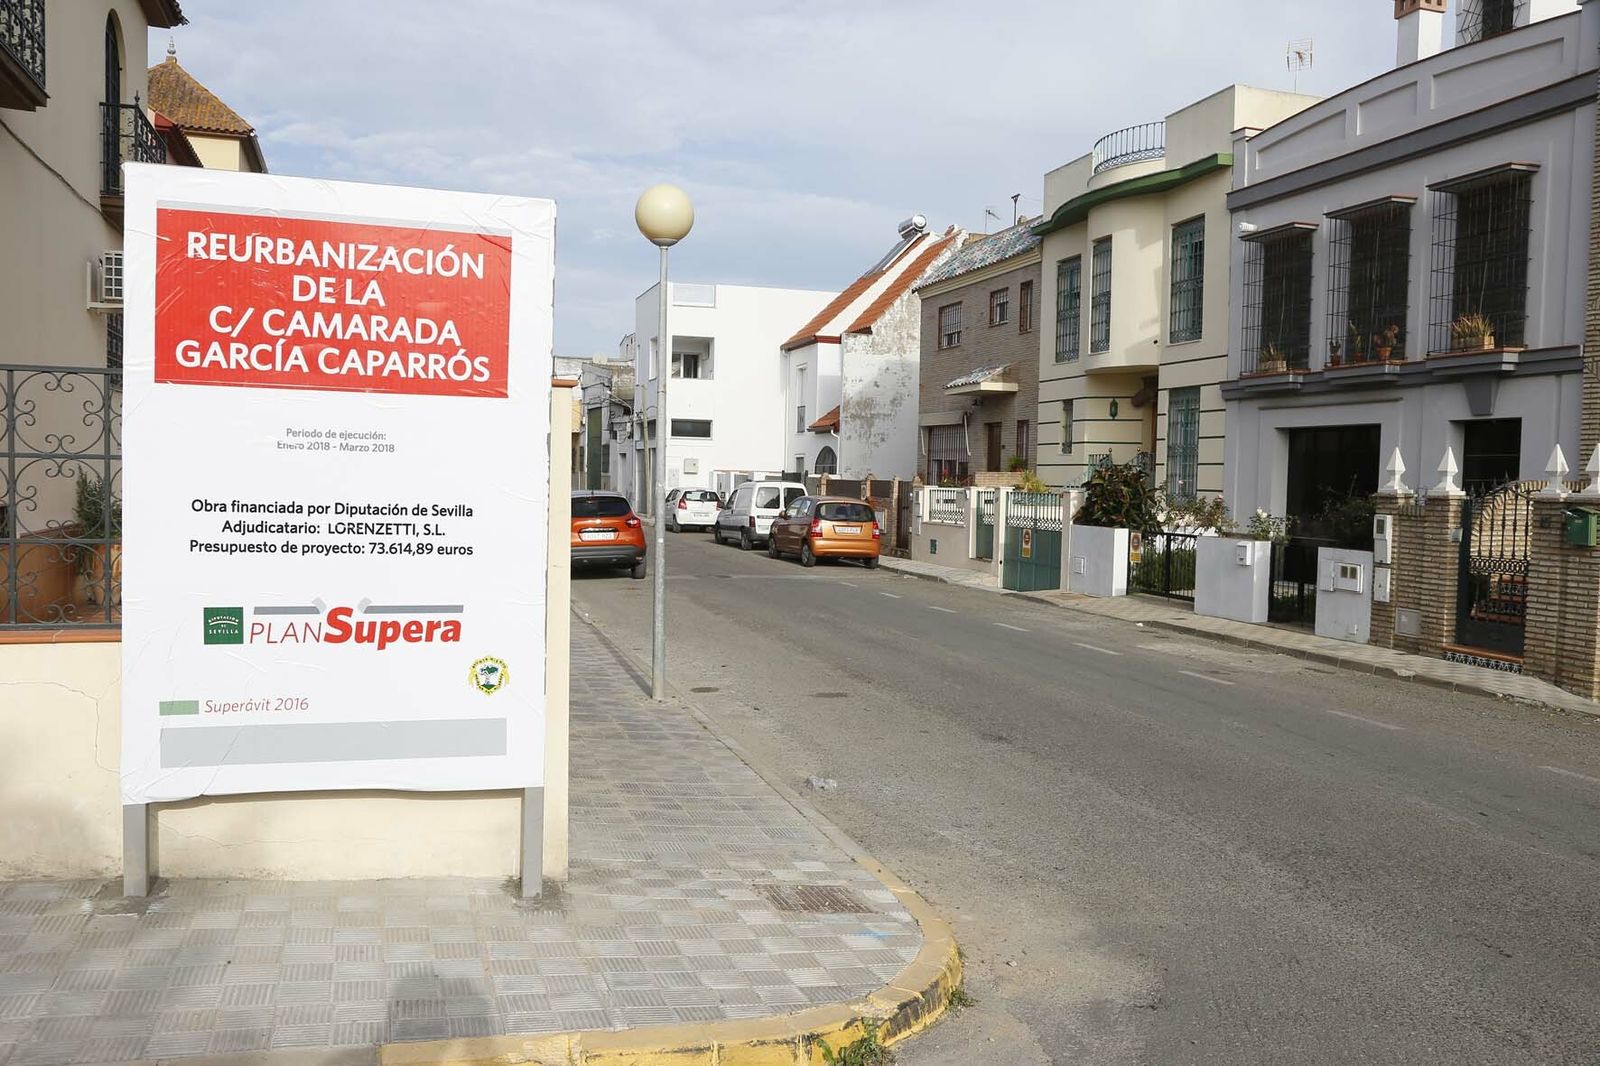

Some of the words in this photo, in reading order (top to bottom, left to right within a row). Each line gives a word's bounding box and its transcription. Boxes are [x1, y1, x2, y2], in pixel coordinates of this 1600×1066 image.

[187, 231, 484, 279] REURBANIZACIÓN
[292, 275, 336, 304] DE
[345, 279, 385, 307] LA
[208, 305, 254, 338] C/
[262, 308, 462, 346] CAMARADA
[175, 339, 309, 373] GARCÍA
[317, 348, 490, 382] CAPARRÓS
[286, 428, 323, 438] Periodo
[325, 429, 337, 439] de
[339, 430, 387, 441] ejecución:
[277, 440, 305, 450] Enero
[307, 441, 330, 451] 2018
[339, 443, 370, 452] Marzo
[372, 443, 395, 453] 2018
[191, 499, 227, 513] Obra
[231, 500, 303, 514] financiada
[307, 504, 331, 518] por
[334, 502, 408, 518] Diputación
[412, 503, 428, 516] de
[431, 504, 473, 517] Sevilla
[222, 521, 320, 536] Adjudicatario:
[328, 523, 420, 537] LORENZETTI,
[423, 524, 445, 536] S.L.
[190, 540, 277, 555] Presupuesto
[281, 541, 298, 553] de
[302, 542, 365, 556] proyecto:
[369, 542, 433, 556] 73.614,89
[437, 545, 473, 555] euros
[249, 621, 323, 644] PLAN
[324, 606, 462, 650] Supera
[204, 698, 271, 715] Superávit
[275, 698, 309, 711] 2016
